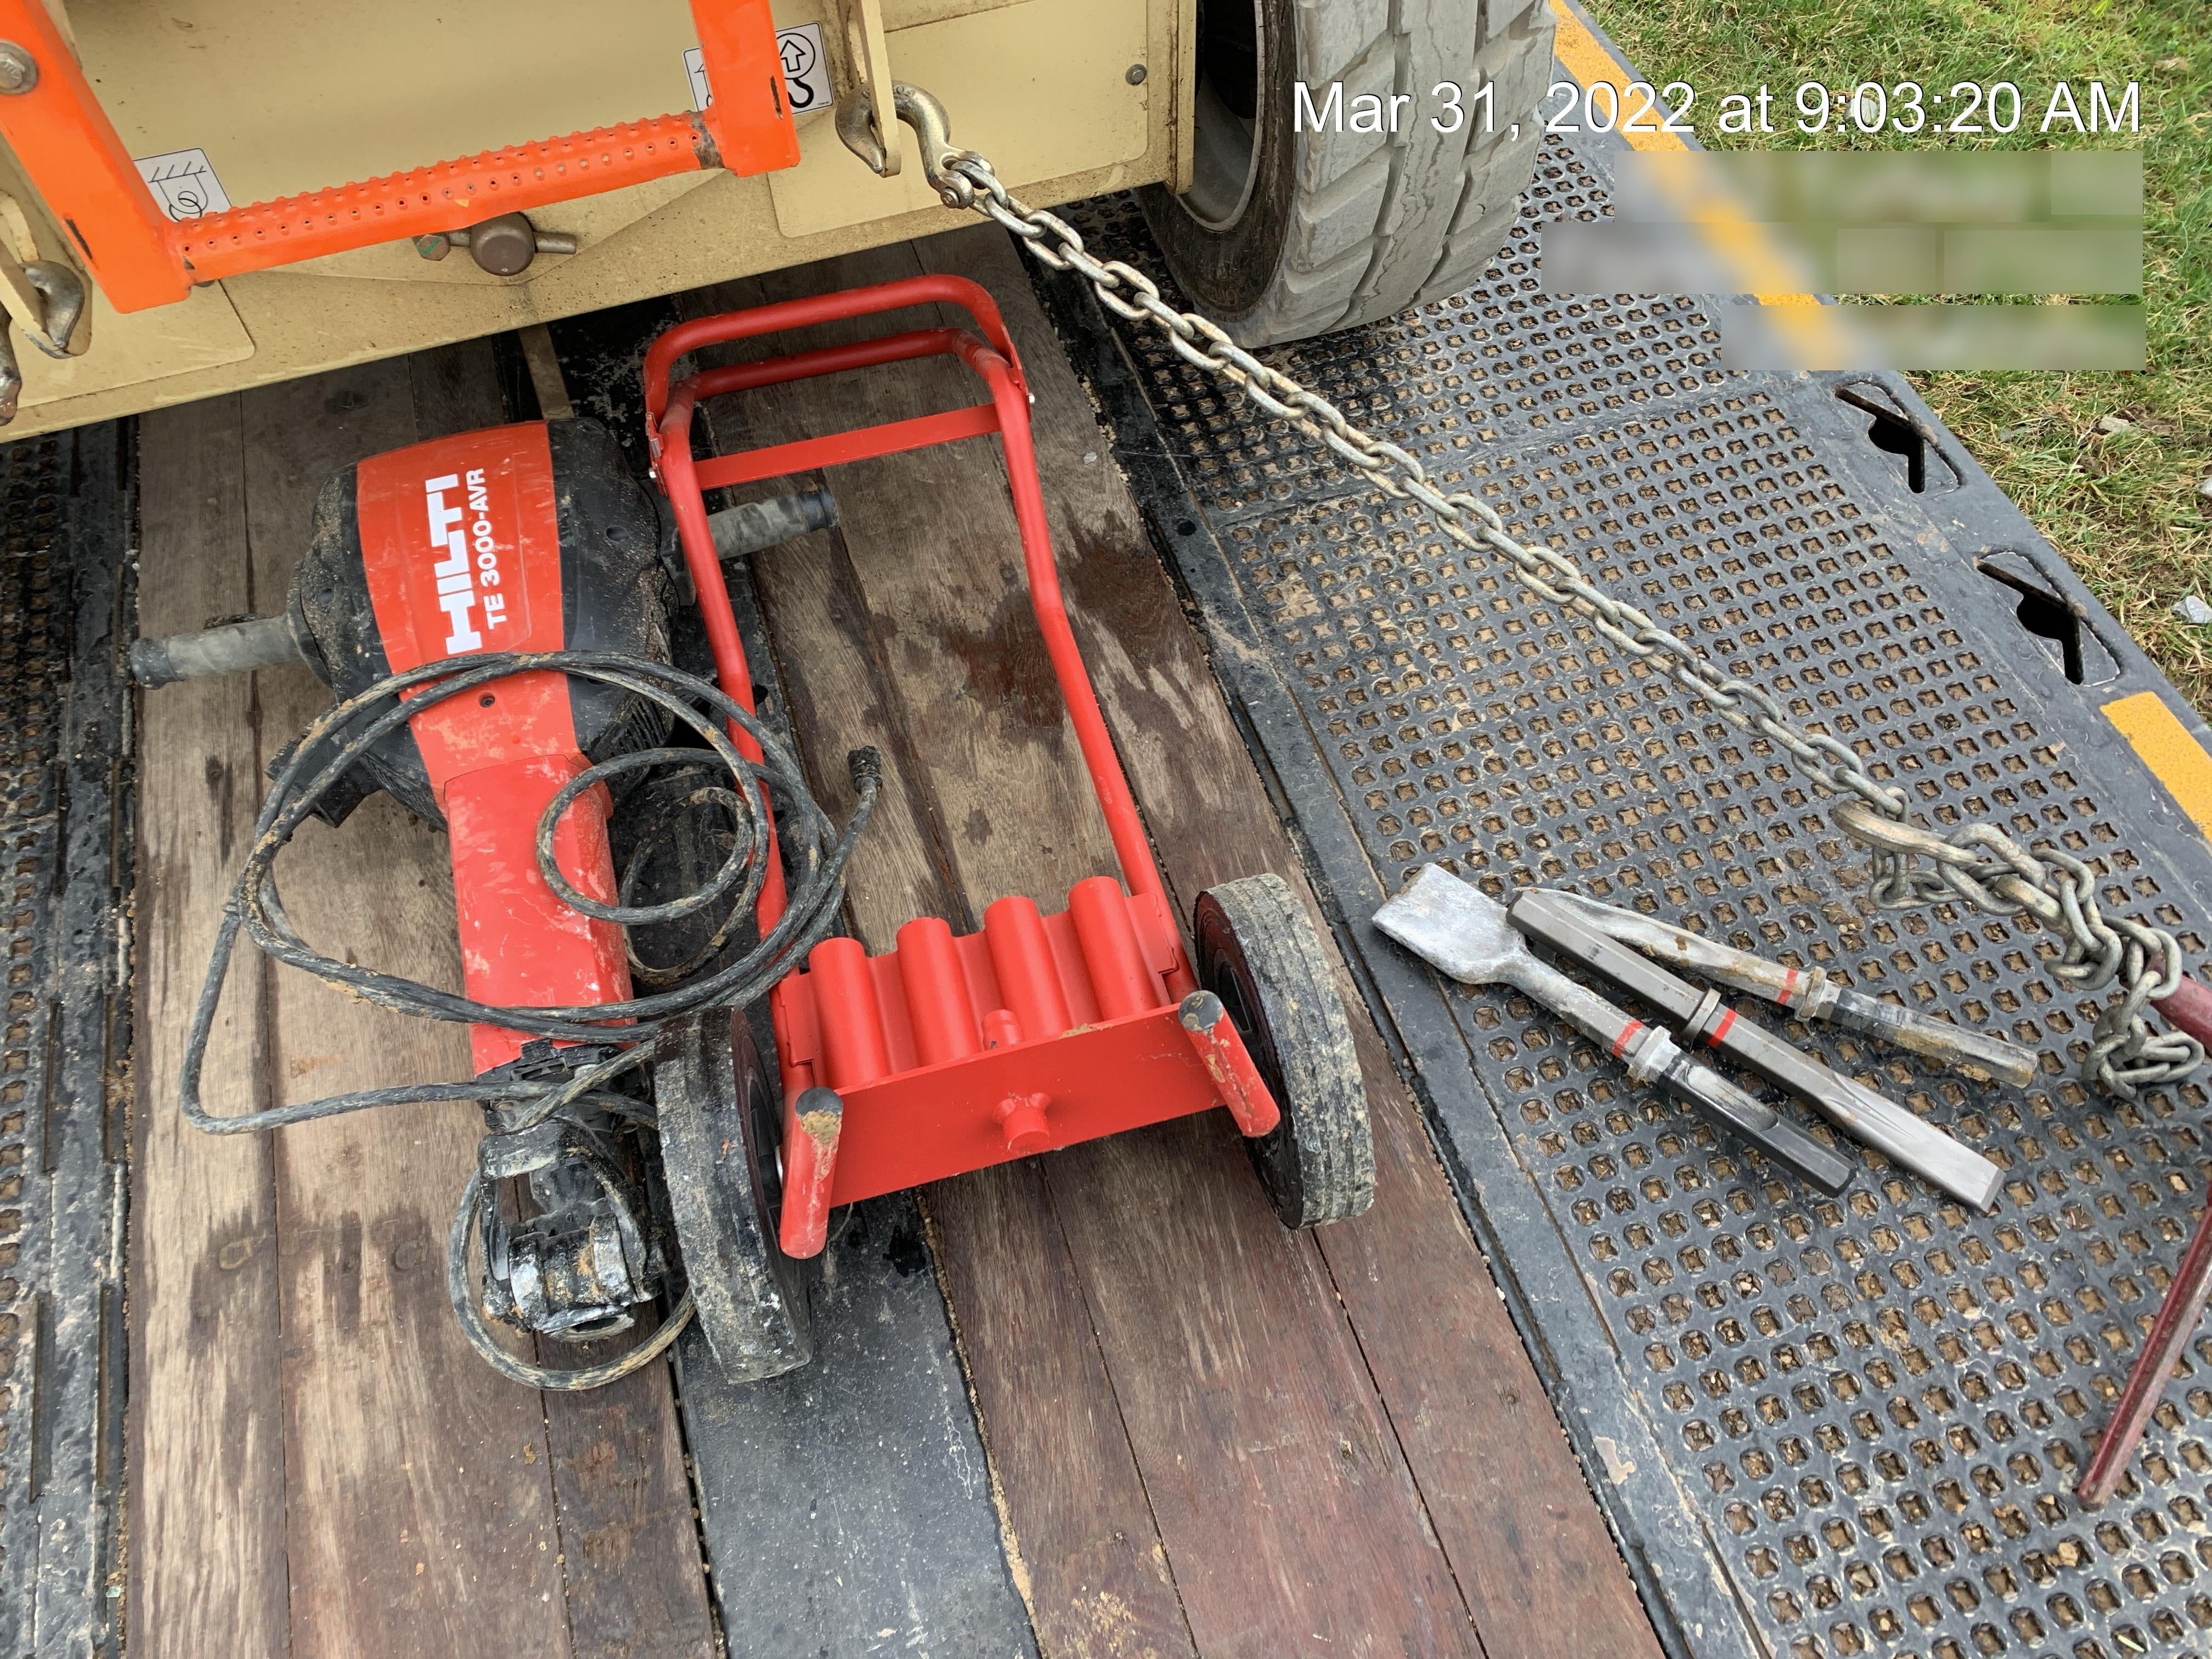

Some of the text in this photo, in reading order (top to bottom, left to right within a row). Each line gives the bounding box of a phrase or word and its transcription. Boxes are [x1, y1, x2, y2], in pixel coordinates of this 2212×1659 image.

[425, 473, 483, 655] HILTI
[465, 468, 507, 630] TE 3000-AVR
